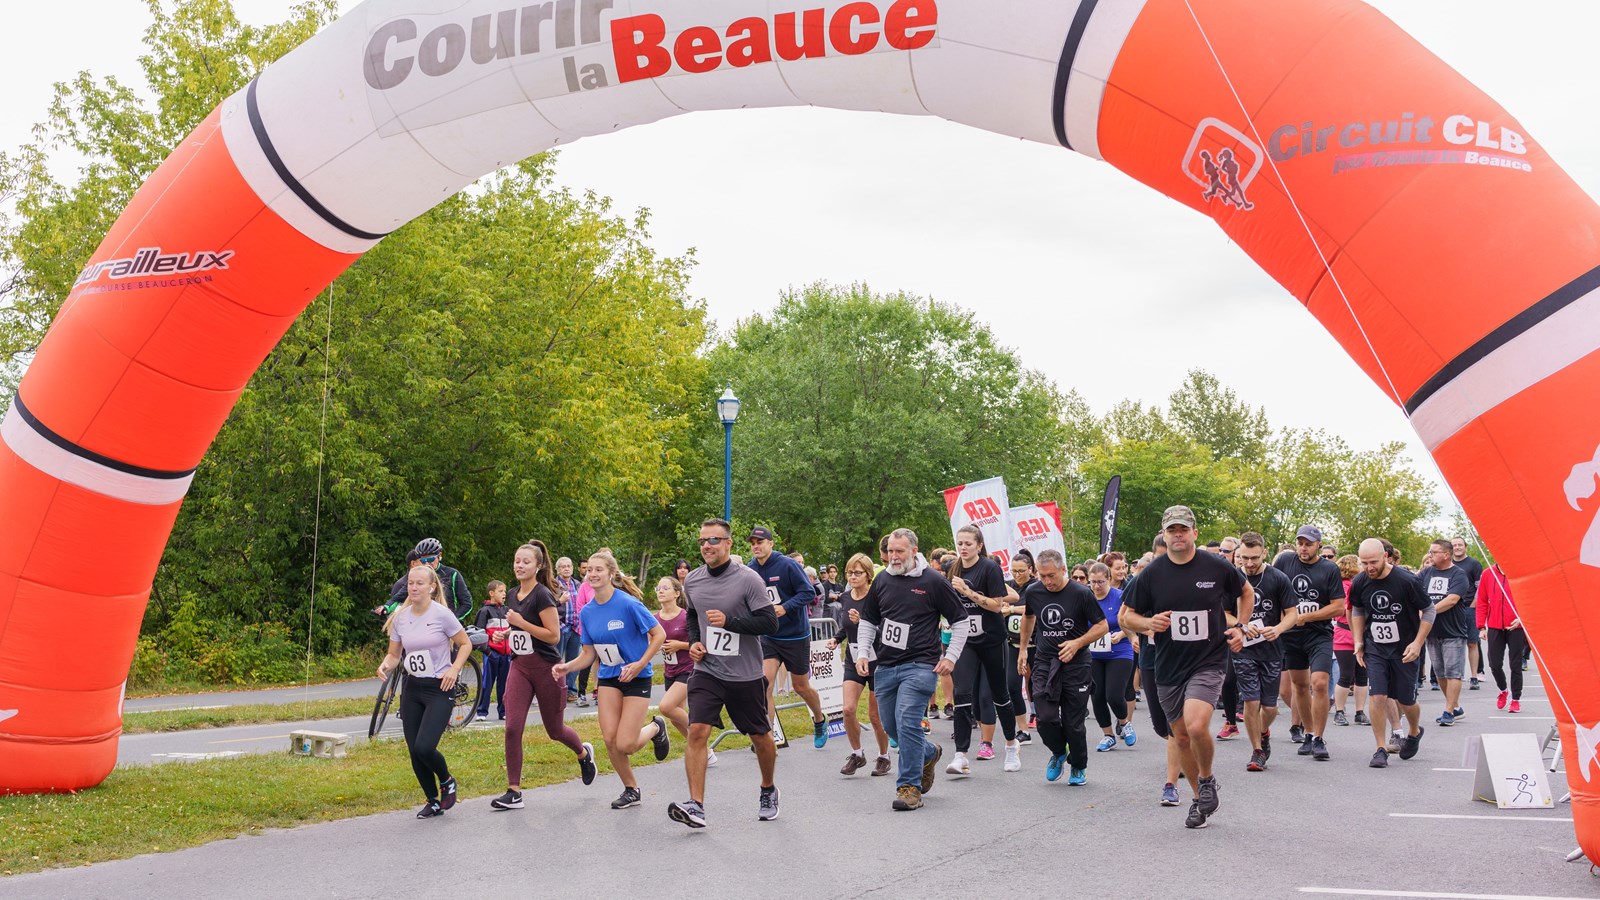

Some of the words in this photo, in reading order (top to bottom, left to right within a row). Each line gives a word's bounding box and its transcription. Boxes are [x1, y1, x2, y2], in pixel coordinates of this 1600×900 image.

[363, 0, 613, 90] Courir
[562, 56, 608, 92] la
[609, 0, 938, 84] Beauce
[1267, 112, 1435, 163] Circuit
[1442, 114, 1527, 155] CLB
[1464, 151, 1532, 172] Beauce
[138, 275, 213, 288] BEAUCERON
[1432, 580, 1443, 591] 43
[885, 624, 902, 644] 59
[968, 619, 977, 633] 5
[1178, 615, 1199, 636] 81
[1376, 626, 1393, 640] 33
[512, 634, 527, 651] 62
[713, 632, 732, 652] 72
[409, 654, 426, 672] 63
[604, 648, 612, 662] 1
[811, 664, 833, 677] Xpress
